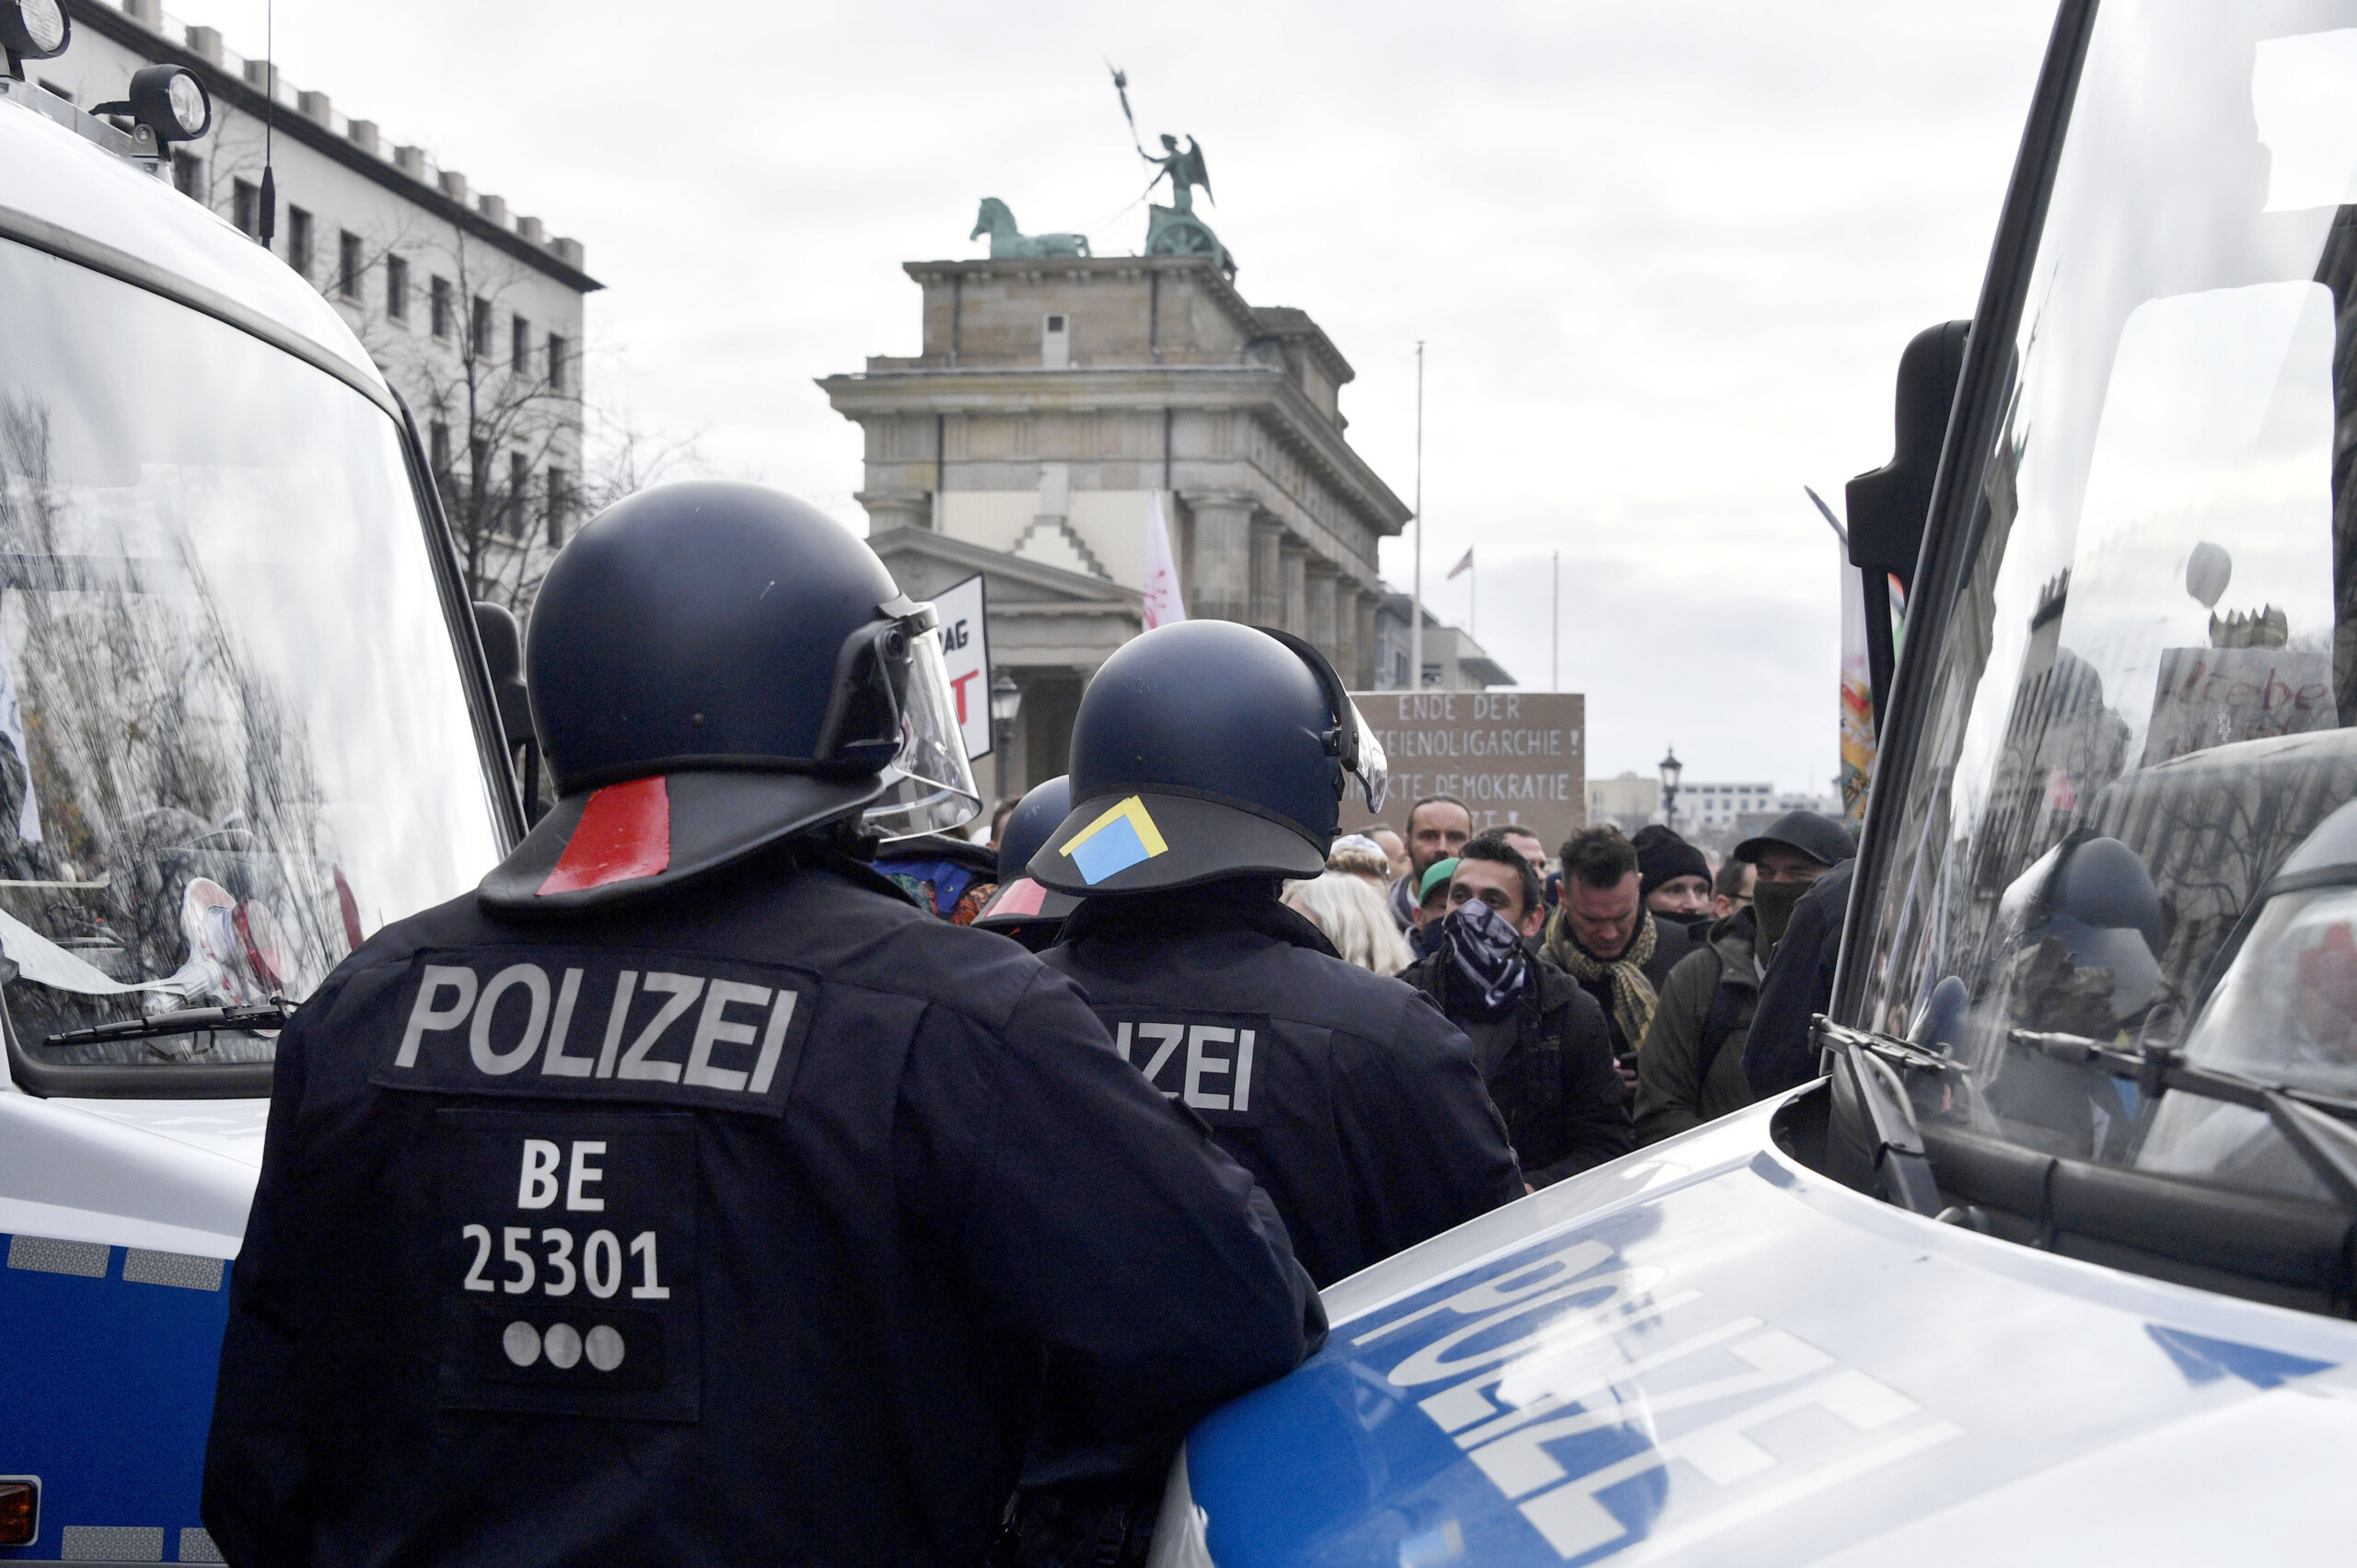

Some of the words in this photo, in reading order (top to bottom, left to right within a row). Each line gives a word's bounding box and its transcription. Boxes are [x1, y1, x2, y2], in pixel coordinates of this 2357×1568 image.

[938, 613, 969, 656] AG
[1399, 694, 1456, 721] ENDE
[1473, 694, 1520, 721] DER
[1434, 772, 1571, 801] DEMOKRATIE
[394, 963, 799, 1094] POLIZEI
[517, 1139, 607, 1212] BE
[462, 1224, 671, 1300] 25301
[1350, 1239, 1967, 1567] POLIZEI
